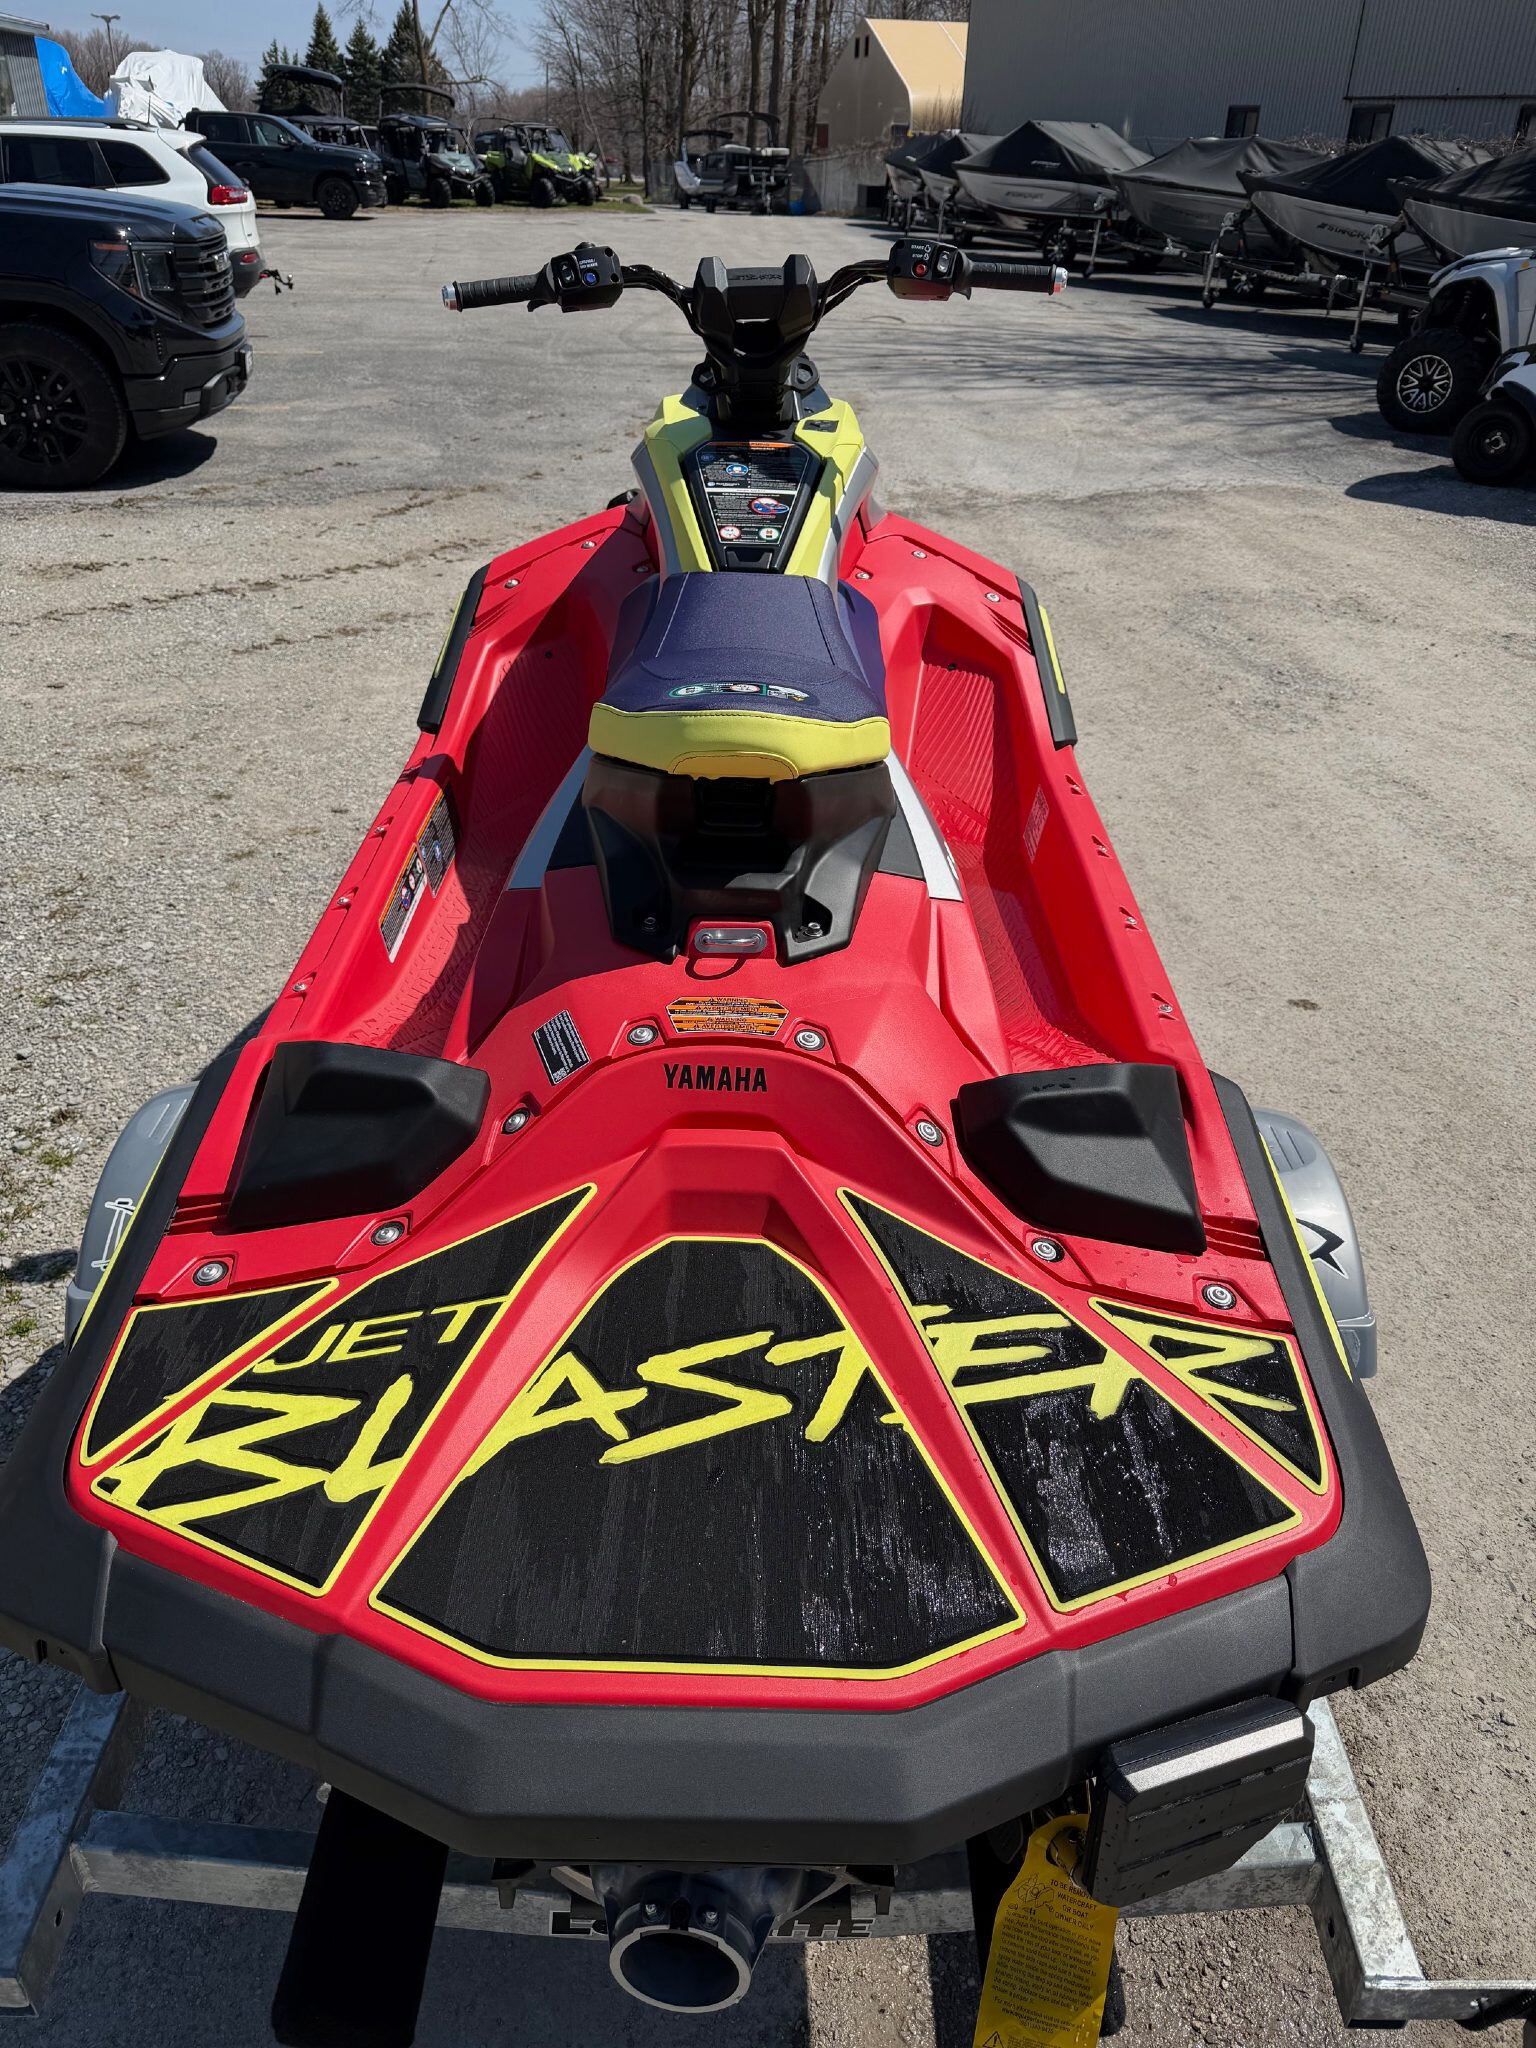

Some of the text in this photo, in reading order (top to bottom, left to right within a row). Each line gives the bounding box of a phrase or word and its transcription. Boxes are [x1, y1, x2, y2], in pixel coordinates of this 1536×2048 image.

[664, 1063, 768, 1092] YAMAHA
[250, 1296, 509, 1374] JET
[98, 1304, 1298, 1526] BLASTER
[1057, 1891, 1098, 1912] WATERCRAFT
